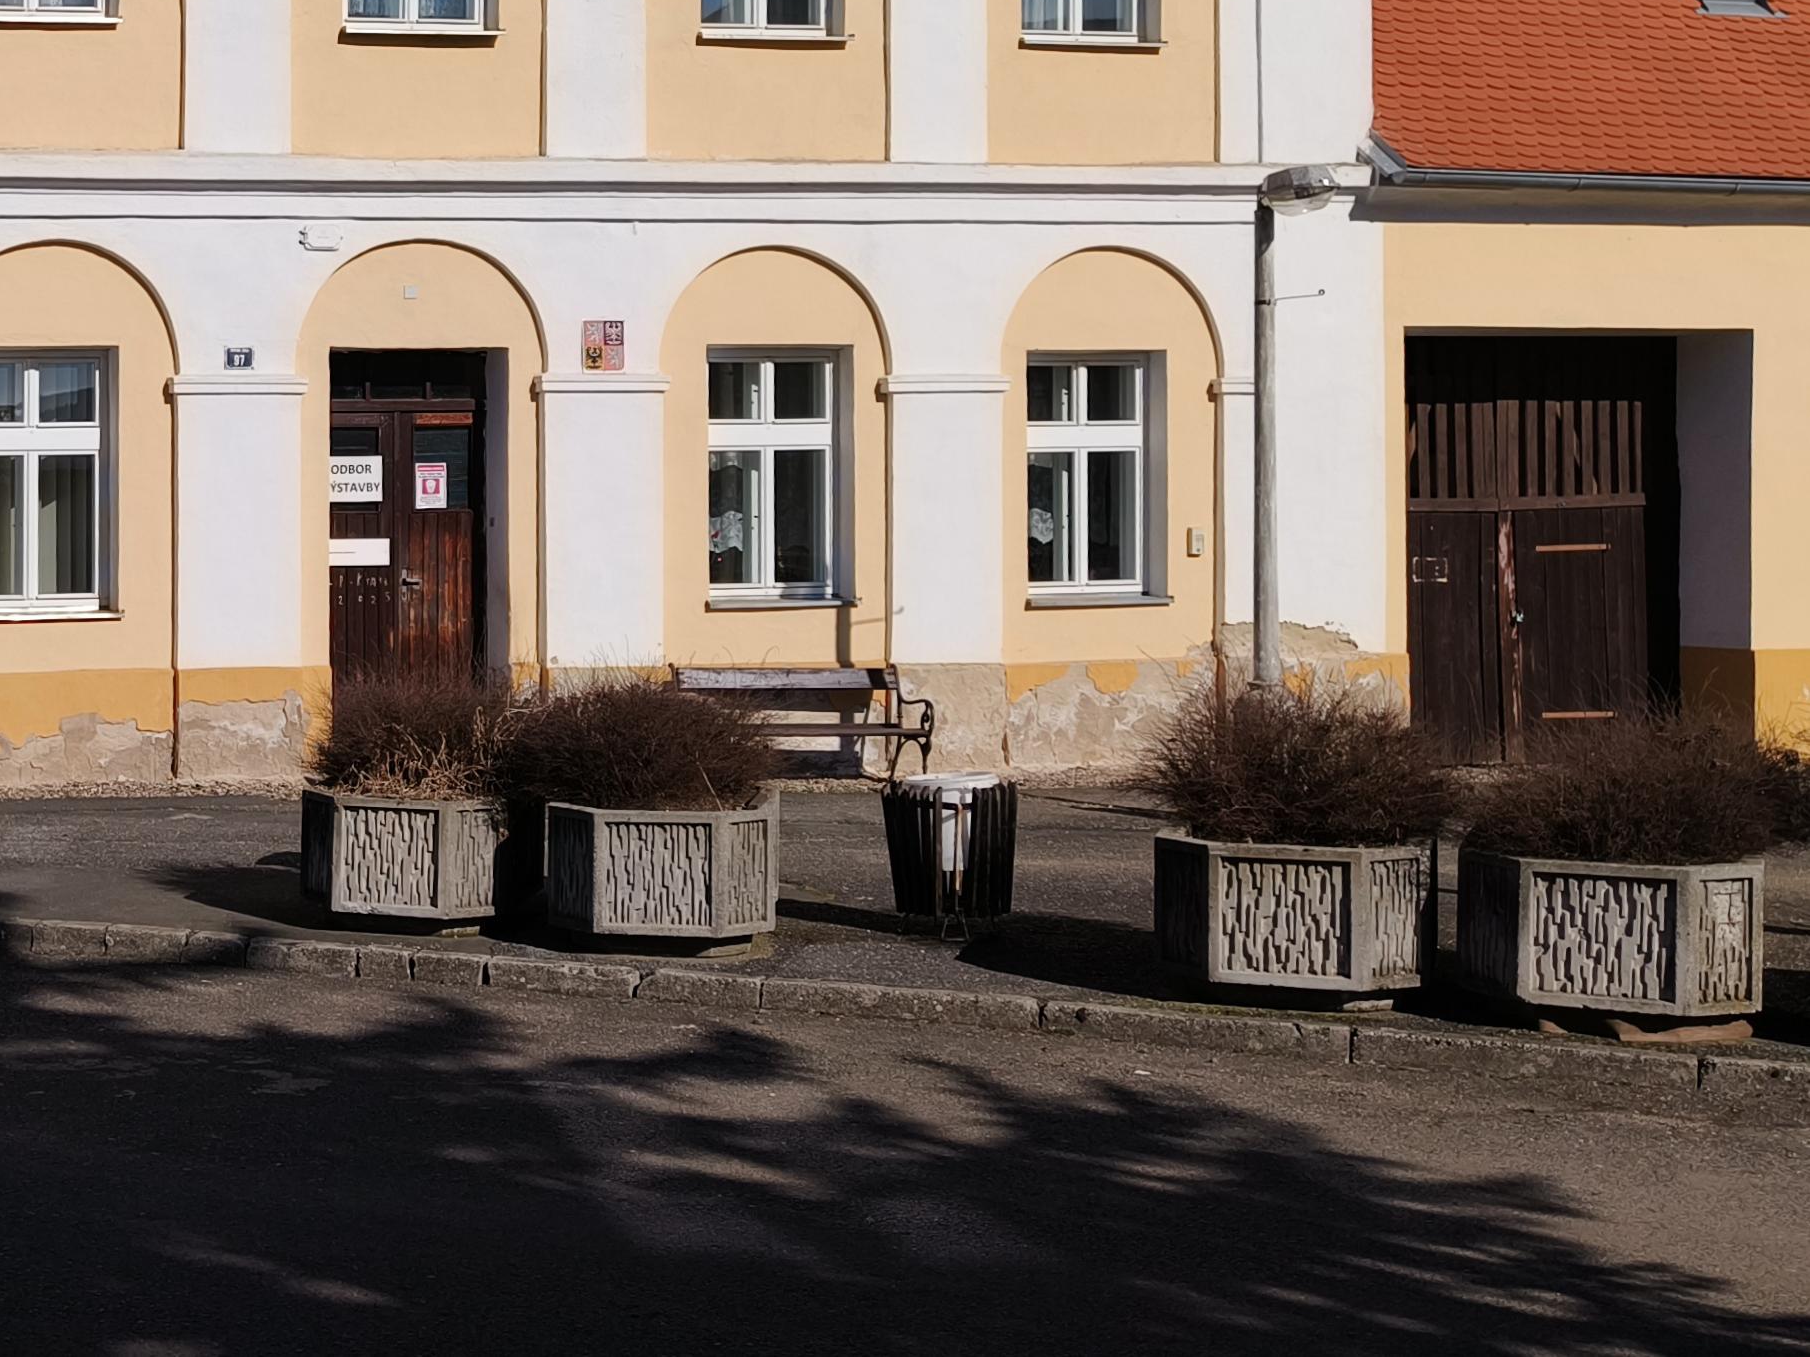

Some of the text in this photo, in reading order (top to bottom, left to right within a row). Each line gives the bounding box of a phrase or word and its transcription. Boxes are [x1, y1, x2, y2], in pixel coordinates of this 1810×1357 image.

[233, 354, 245, 366] 97
[330, 464, 372, 474] ODBOR
[330, 480, 380, 493] ÝSTAVBY
